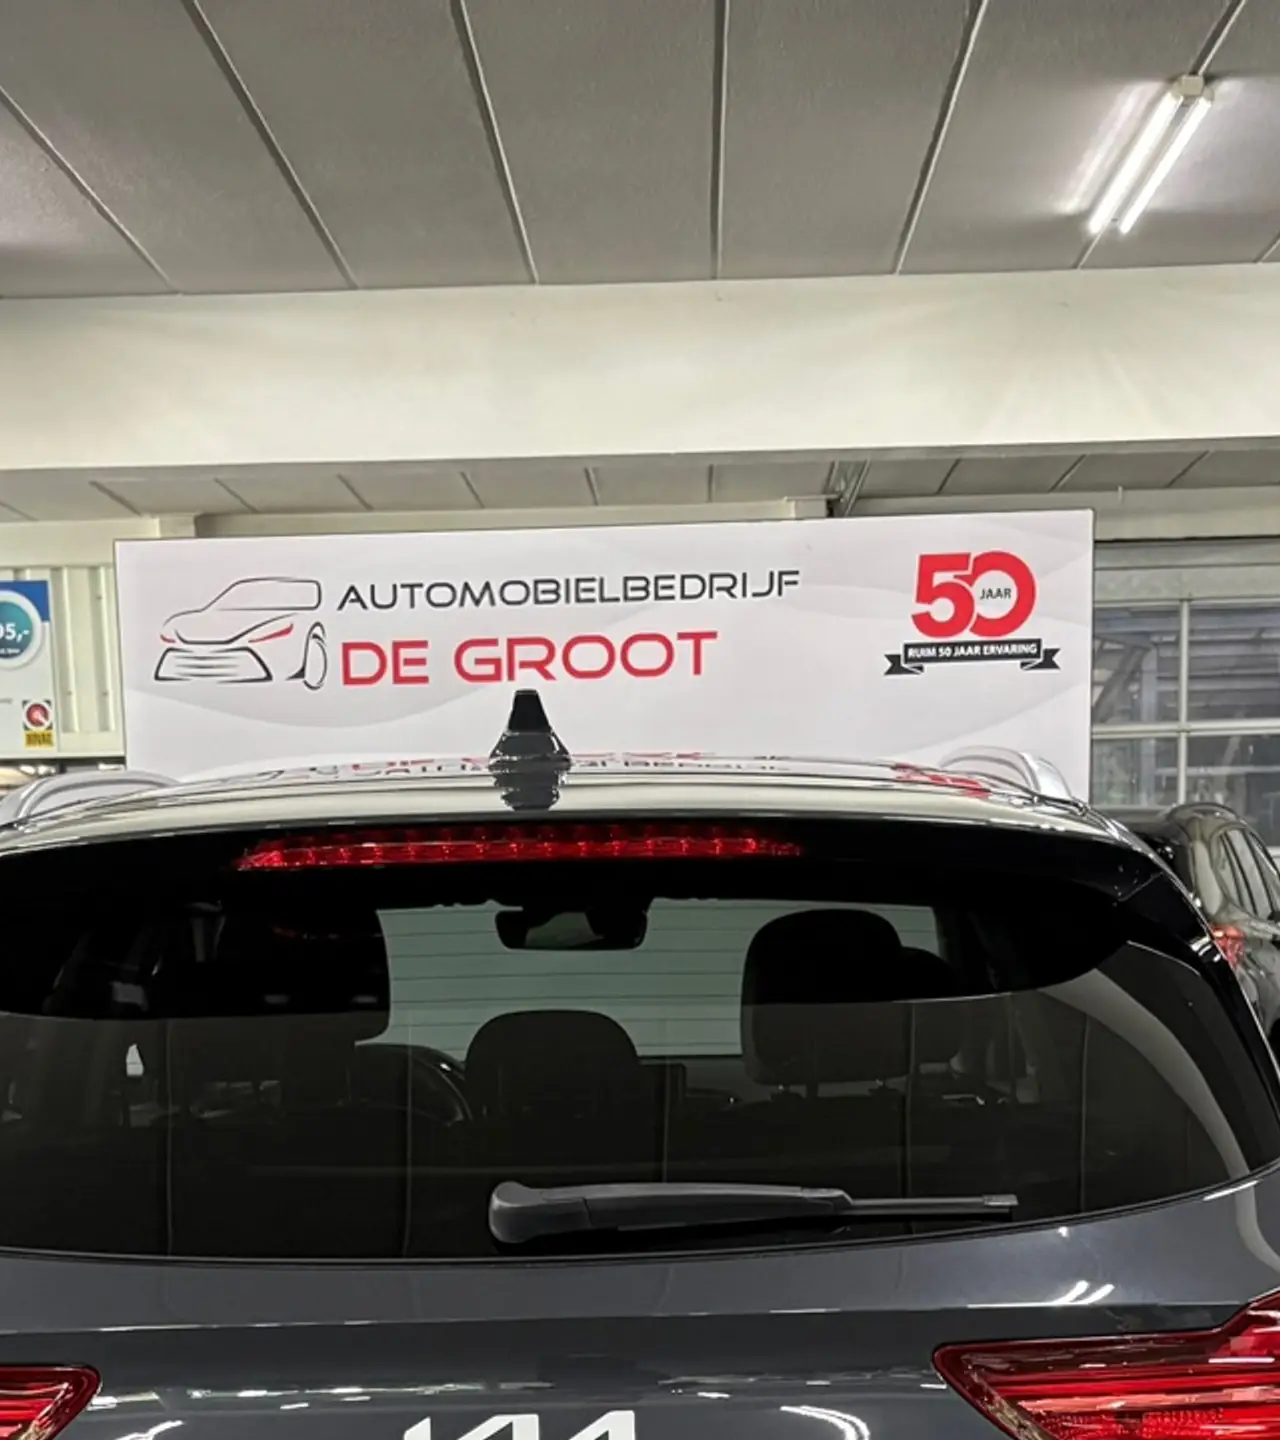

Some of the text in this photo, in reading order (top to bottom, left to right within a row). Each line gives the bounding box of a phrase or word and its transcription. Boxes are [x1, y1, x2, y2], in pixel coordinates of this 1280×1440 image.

[337, 570, 800, 611] AUTOMOBIELBEDRIJF
[911, 550, 1037, 638] 50
[979, 588, 1012, 600] JAAR
[342, 631, 718, 686] DE GROOT
[908, 643, 1038, 658] RUIM 50 JAAR ERVARING
